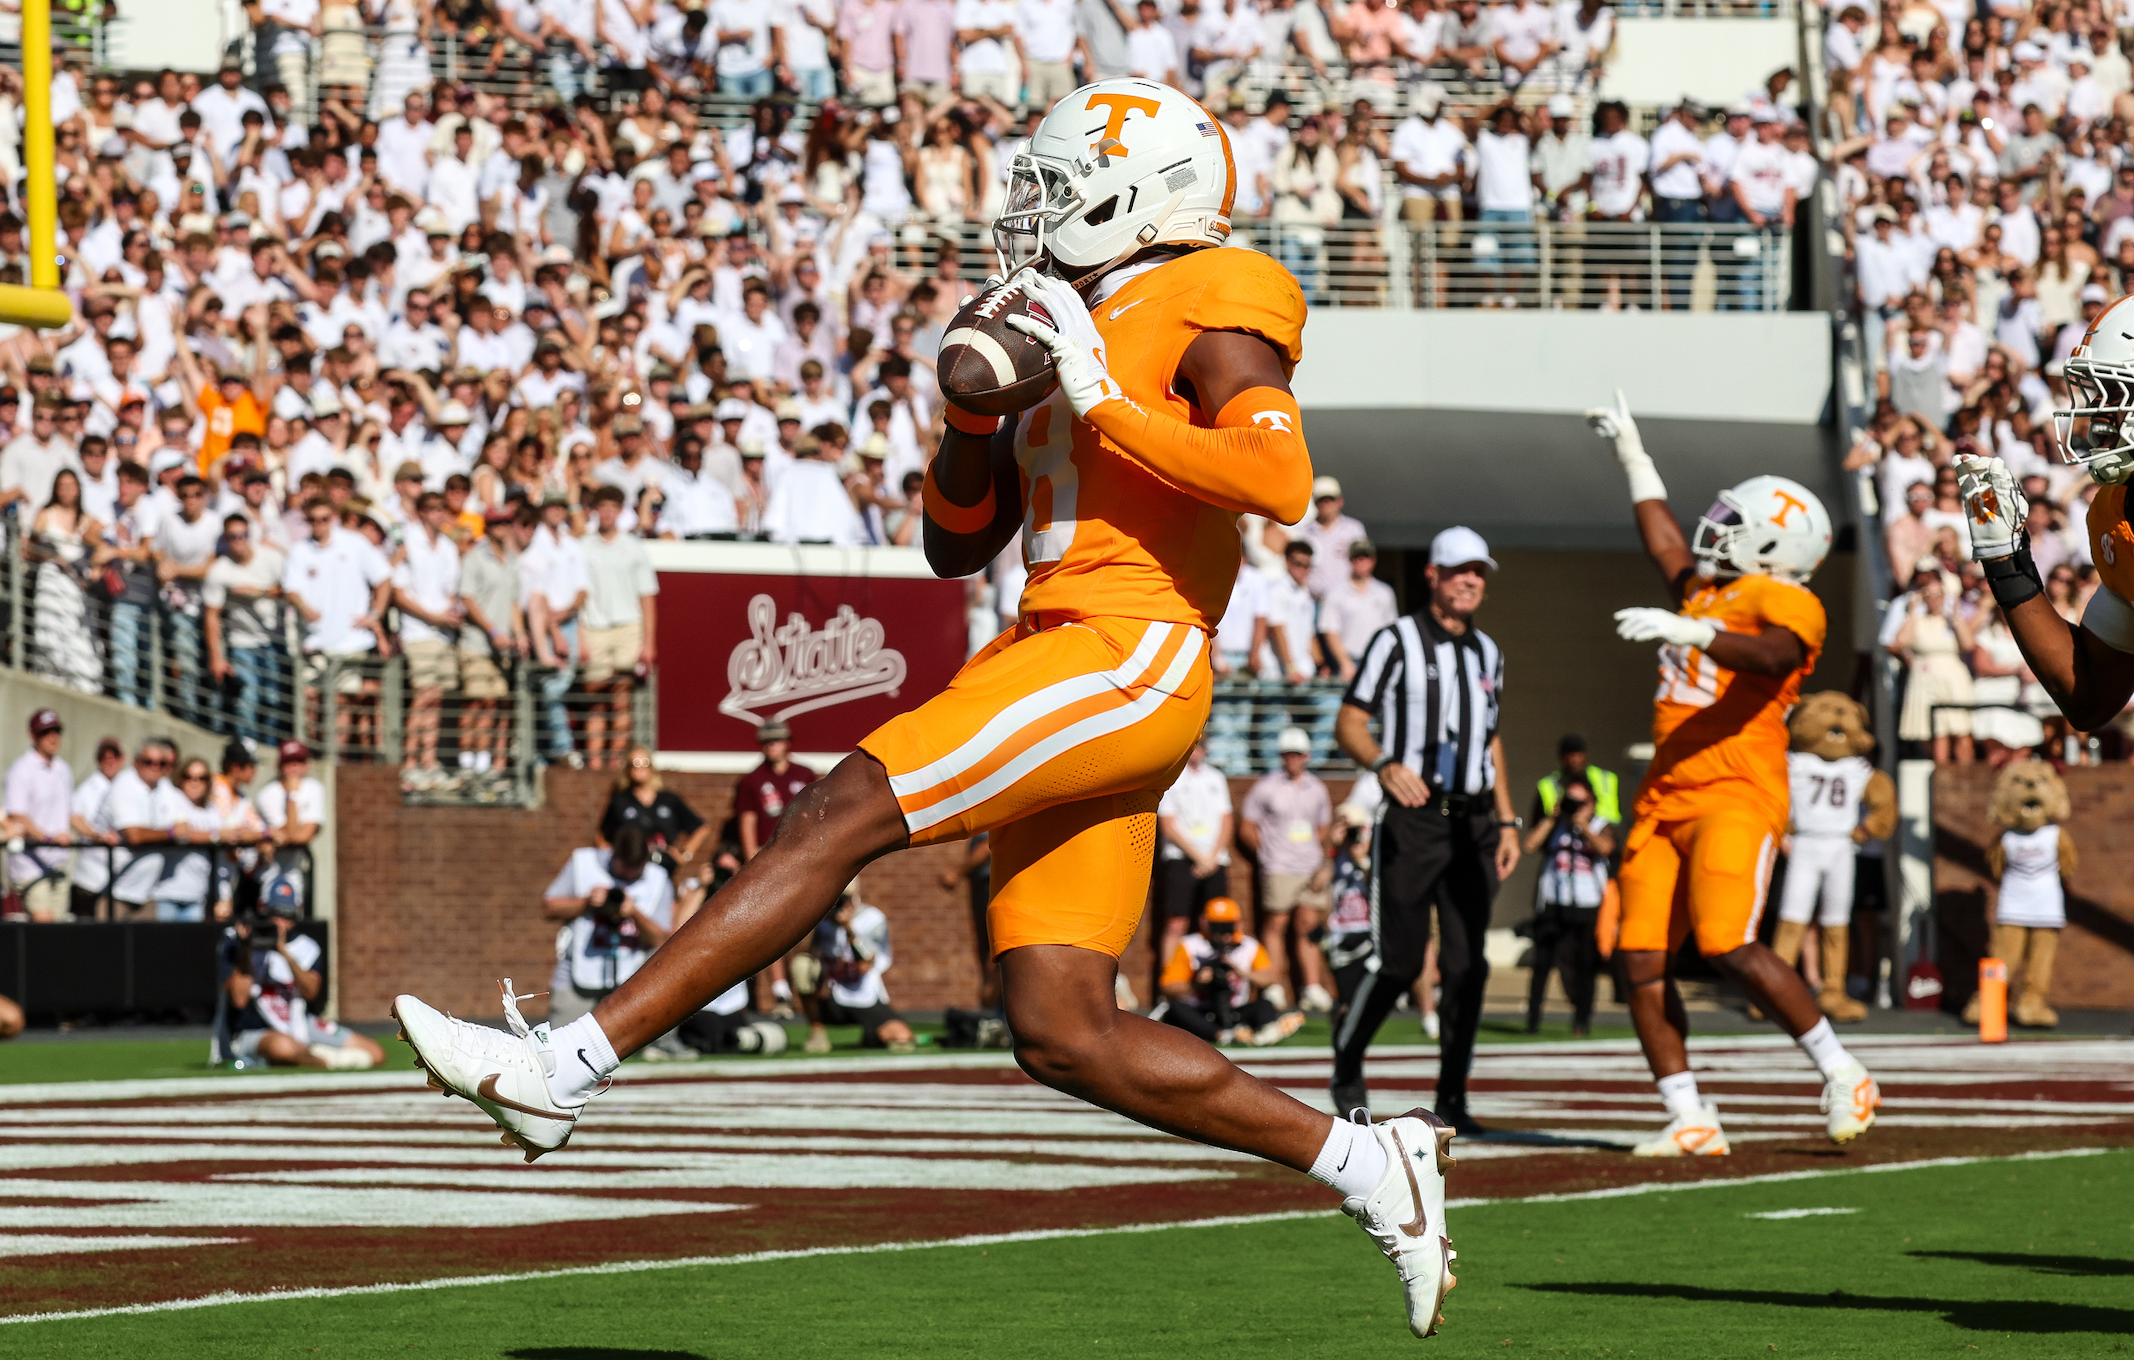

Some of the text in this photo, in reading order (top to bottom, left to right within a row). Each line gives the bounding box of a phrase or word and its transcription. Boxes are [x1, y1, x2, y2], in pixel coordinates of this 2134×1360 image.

[1085, 93, 1161, 157] T
[1251, 410, 1292, 433] T
[1013, 392, 1079, 564] 8
[1769, 489, 1808, 529] T
[721, 593, 904, 710] State
[1809, 775, 1846, 807] 78
